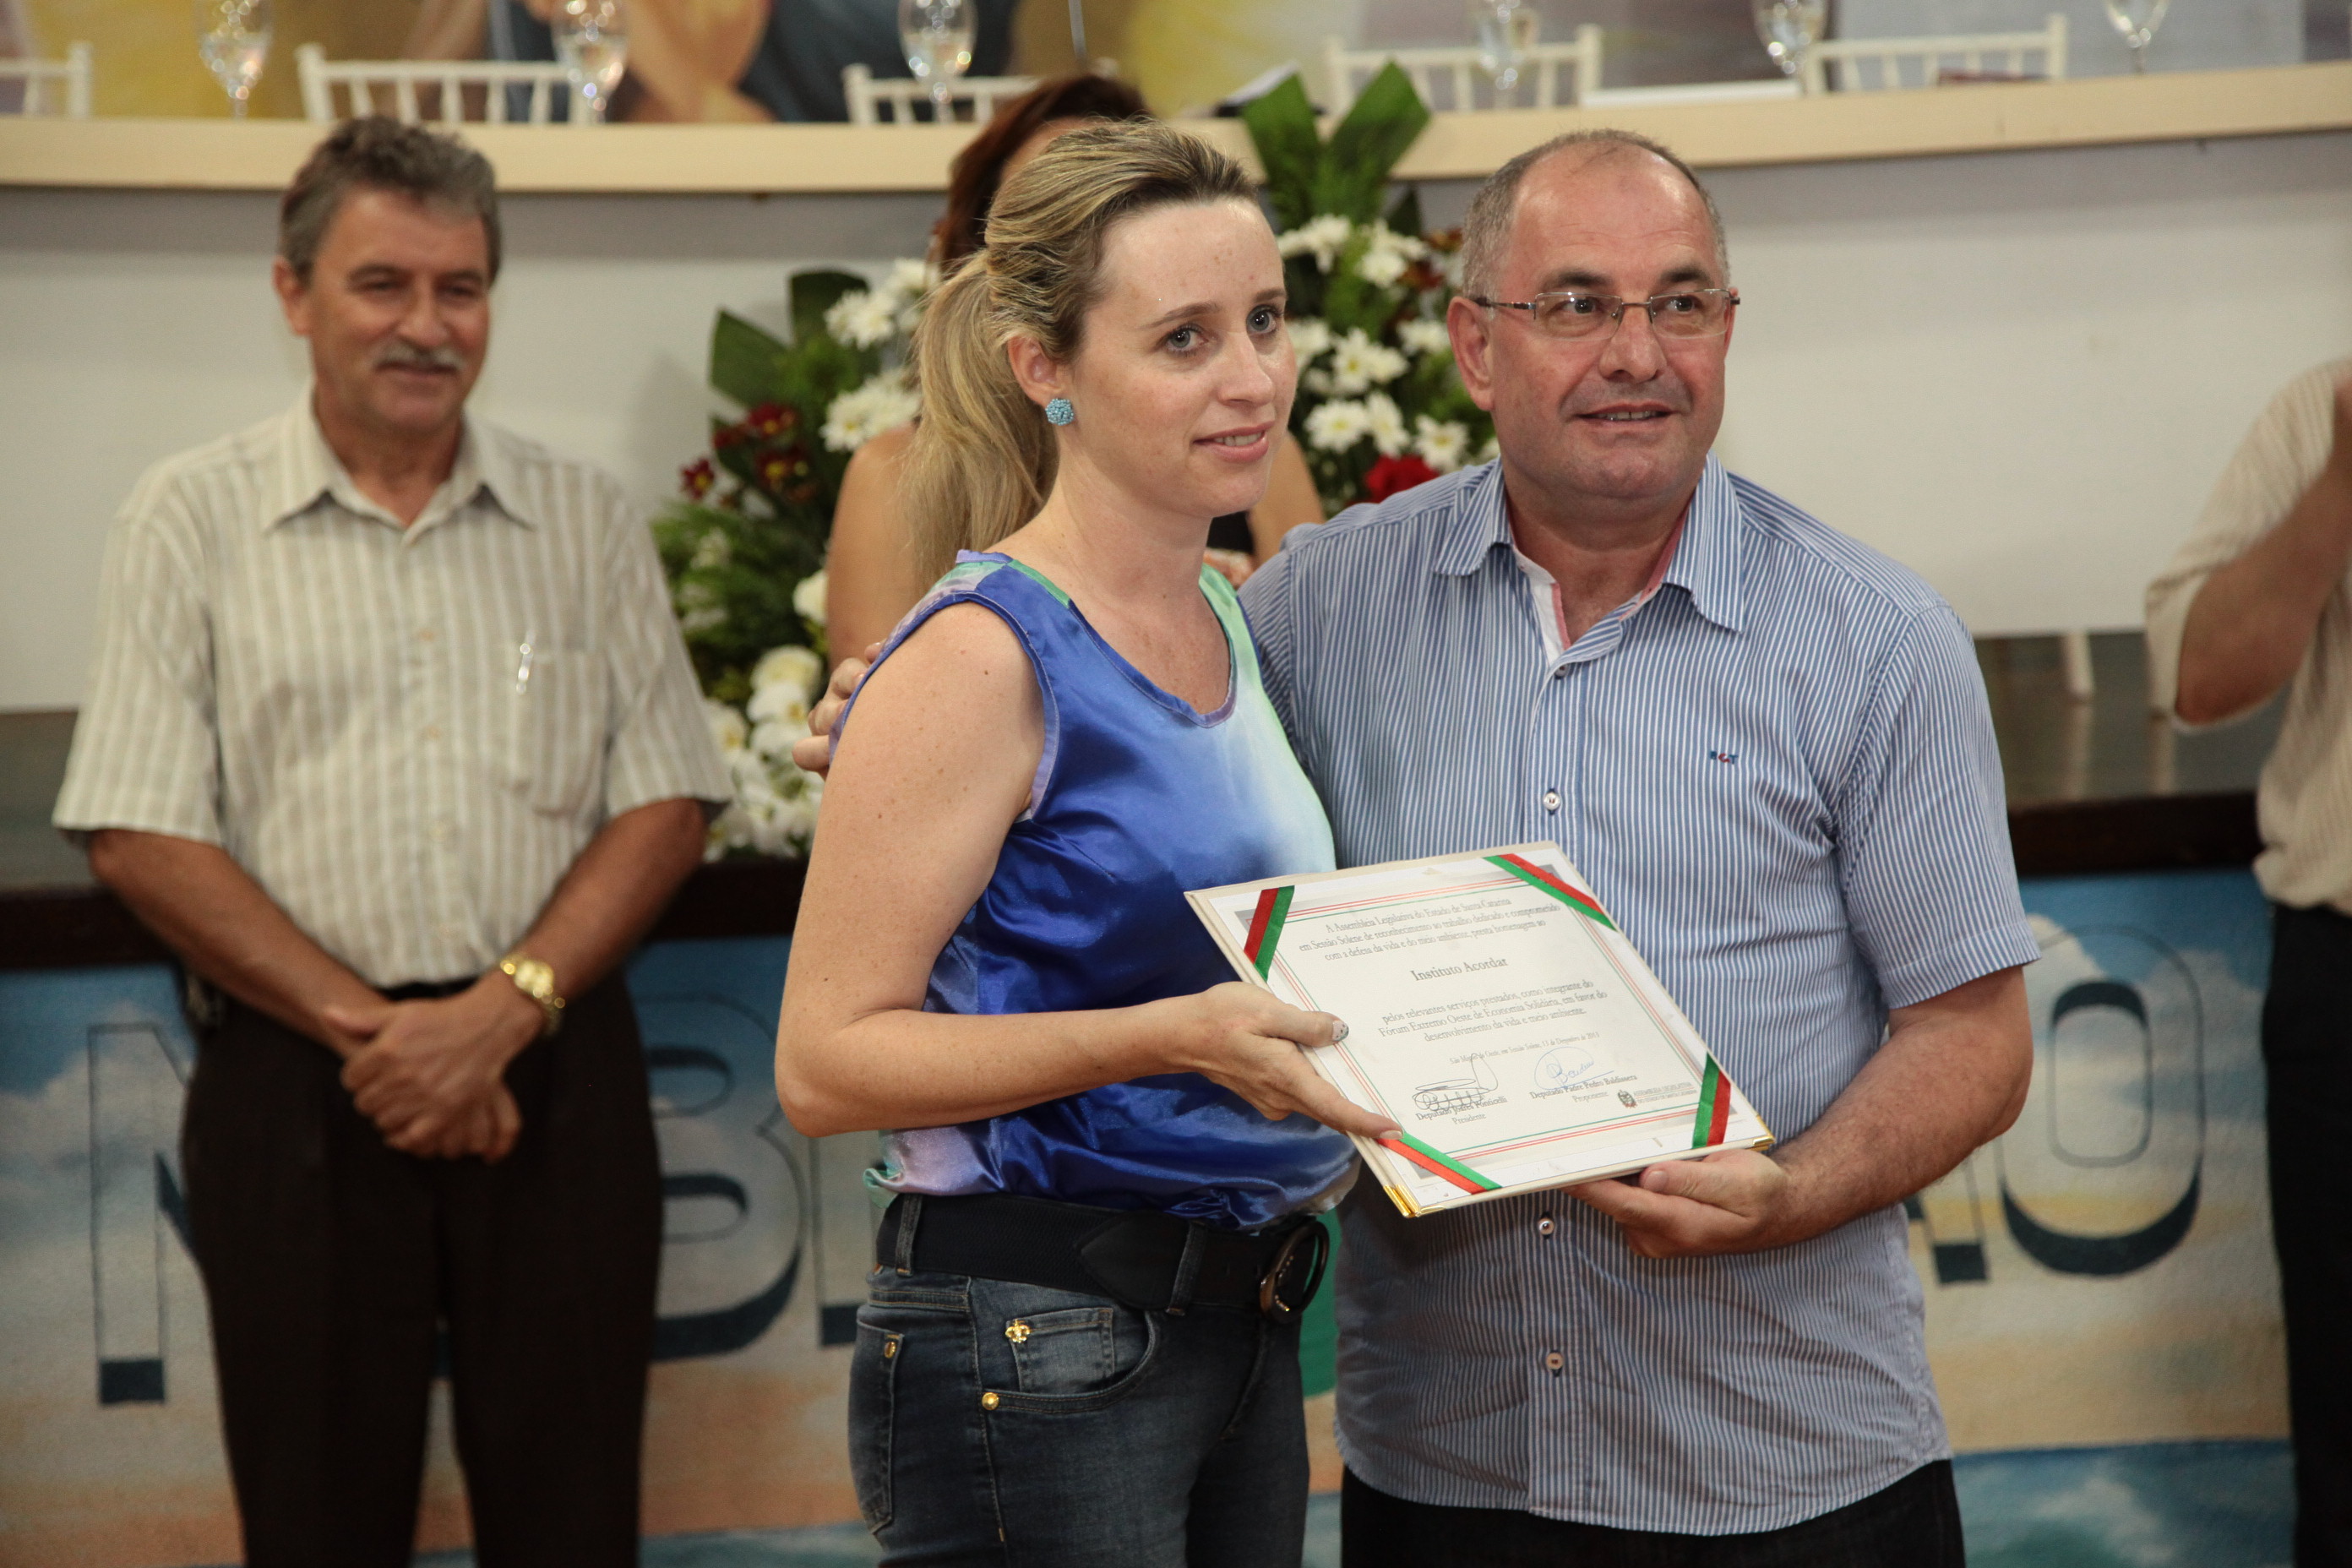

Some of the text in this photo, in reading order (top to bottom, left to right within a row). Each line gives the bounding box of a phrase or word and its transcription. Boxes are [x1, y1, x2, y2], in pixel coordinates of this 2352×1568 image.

[1299, 943, 1312, 951] em
[1311, 939, 1338, 950] Sessão
[1337, 934, 1363, 945] Solene
[1364, 932, 1374, 940] de
[1375, 924, 1432, 939] reconhecimento
[1442, 917, 1473, 928] trabalho
[1473, 912, 1505, 923] dedicado
[1511, 903, 1561, 917] comprometido
[1326, 923, 1335, 933] A
[1335, 918, 1376, 931] Assembleia
[1375, 912, 1414, 925] Legislativa
[1424, 906, 1451, 917] Estado
[1452, 905, 1462, 913] de
[1462, 902, 1483, 912] Santa
[1482, 899, 1512, 908] Catarina
[1349, 946, 1372, 956] defesa
[1373, 944, 1384, 952] da
[1383, 940, 1400, 951] vida
[1407, 938, 1418, 946] do
[1418, 935, 1436, 945] meio
[1471, 926, 1495, 939] presta
[1494, 922, 1537, 933] homenagem
[1410, 957, 1508, 981] Instituto Acordar
[1379, 1026, 1410, 1037] Fórum
[1409, 1020, 1447, 1032] Extremo
[1447, 1013, 1473, 1025] Oeste
[1473, 1010, 1484, 1019] de
[1483, 1006, 1525, 1018] Economia
[1562, 995, 1576, 1005] em
[1575, 993, 1596, 1002] favor
[1596, 990, 1609, 999] do
[1382, 979, 1594, 1025] pelos relevantes serviços prestados, como integrante do
[1424, 1024, 1492, 1042] desenvolvimento
[1493, 1020, 1504, 1028] da
[1505, 1017, 1522, 1026] vida
[1528, 1013, 1549, 1022] meio
[1529, 1087, 1564, 1099] Deputado
[1585, 1081, 1605, 1089] Pedro
[1415, 1107, 1452, 1120] Deputado
[1451, 1113, 1488, 1124] Presidente
